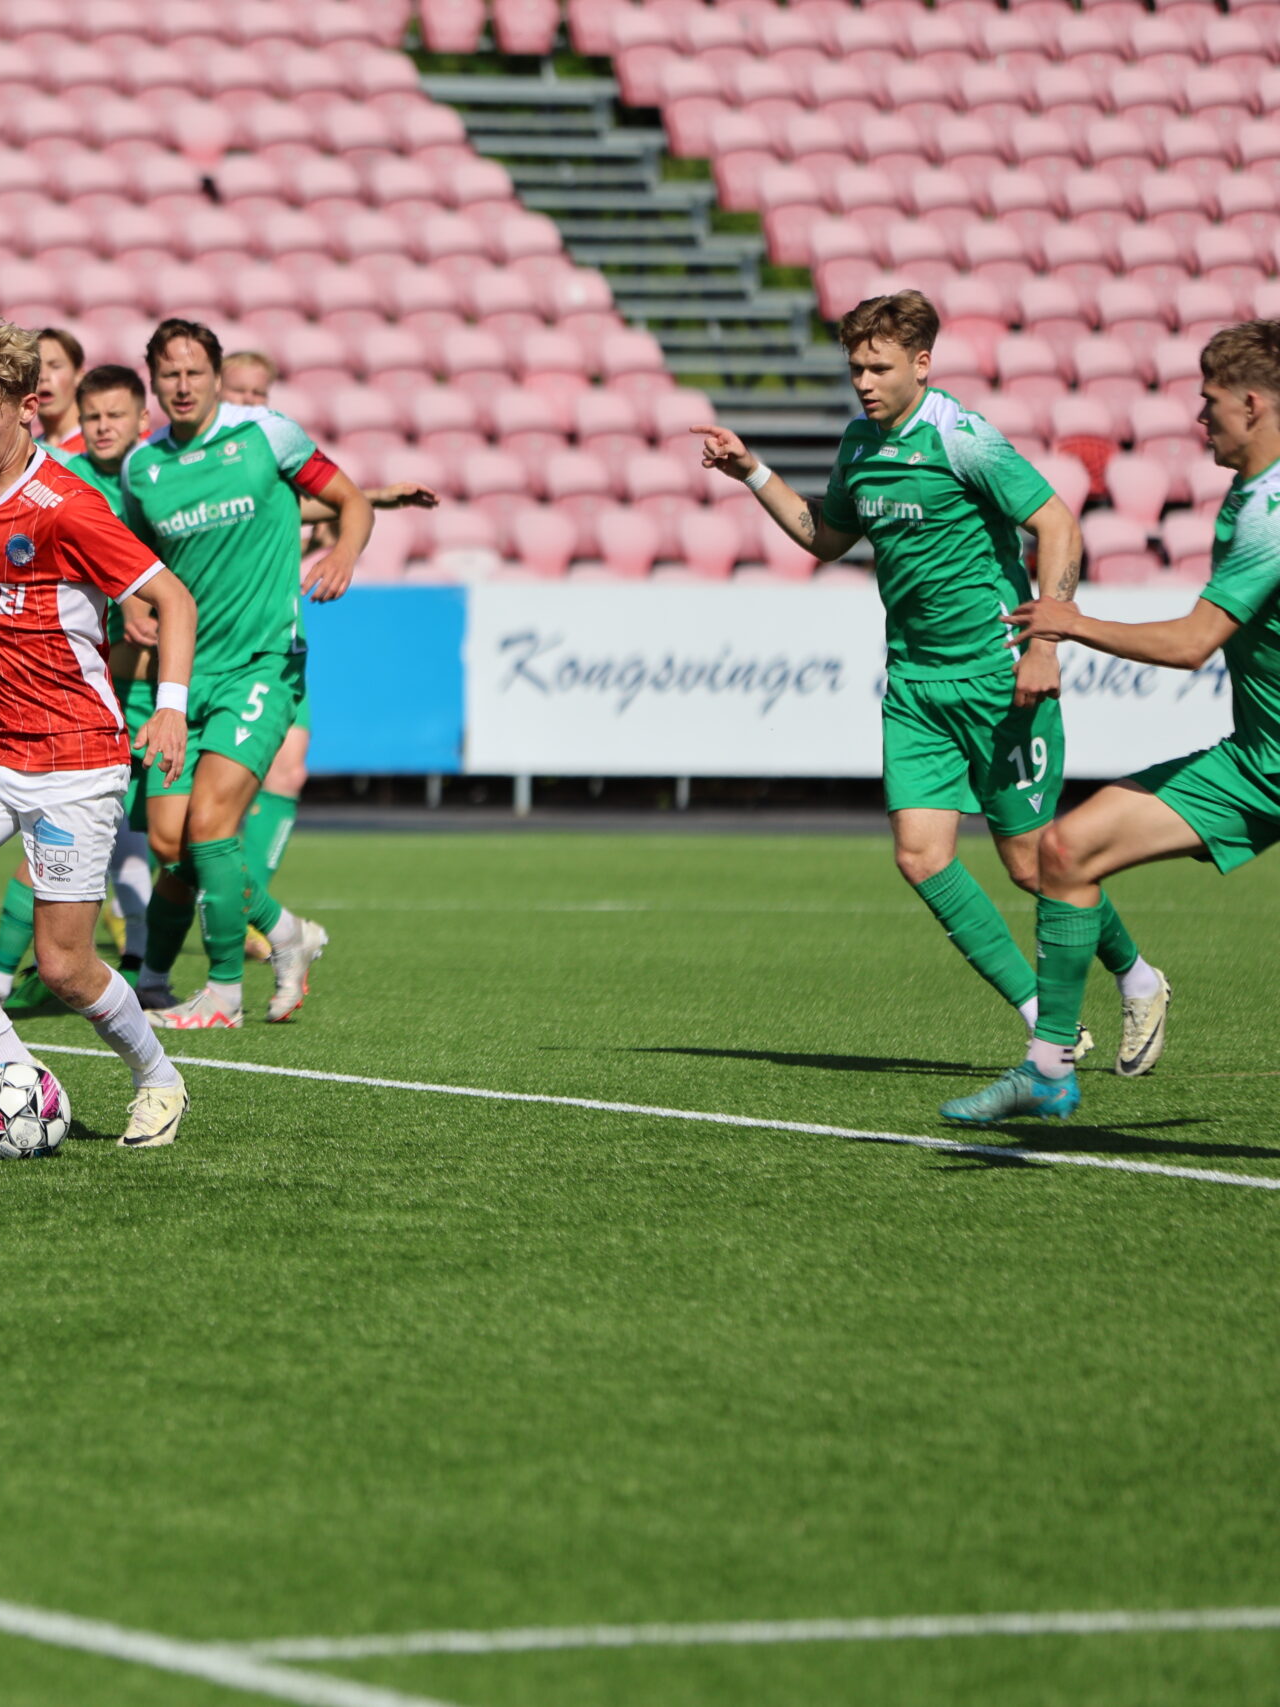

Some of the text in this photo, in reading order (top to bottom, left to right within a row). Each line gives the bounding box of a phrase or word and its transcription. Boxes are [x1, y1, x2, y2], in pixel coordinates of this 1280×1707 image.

[497, 627, 847, 715] Kongsvinger
[241, 682, 269, 721] 5
[1007, 736, 1047, 790] 19
